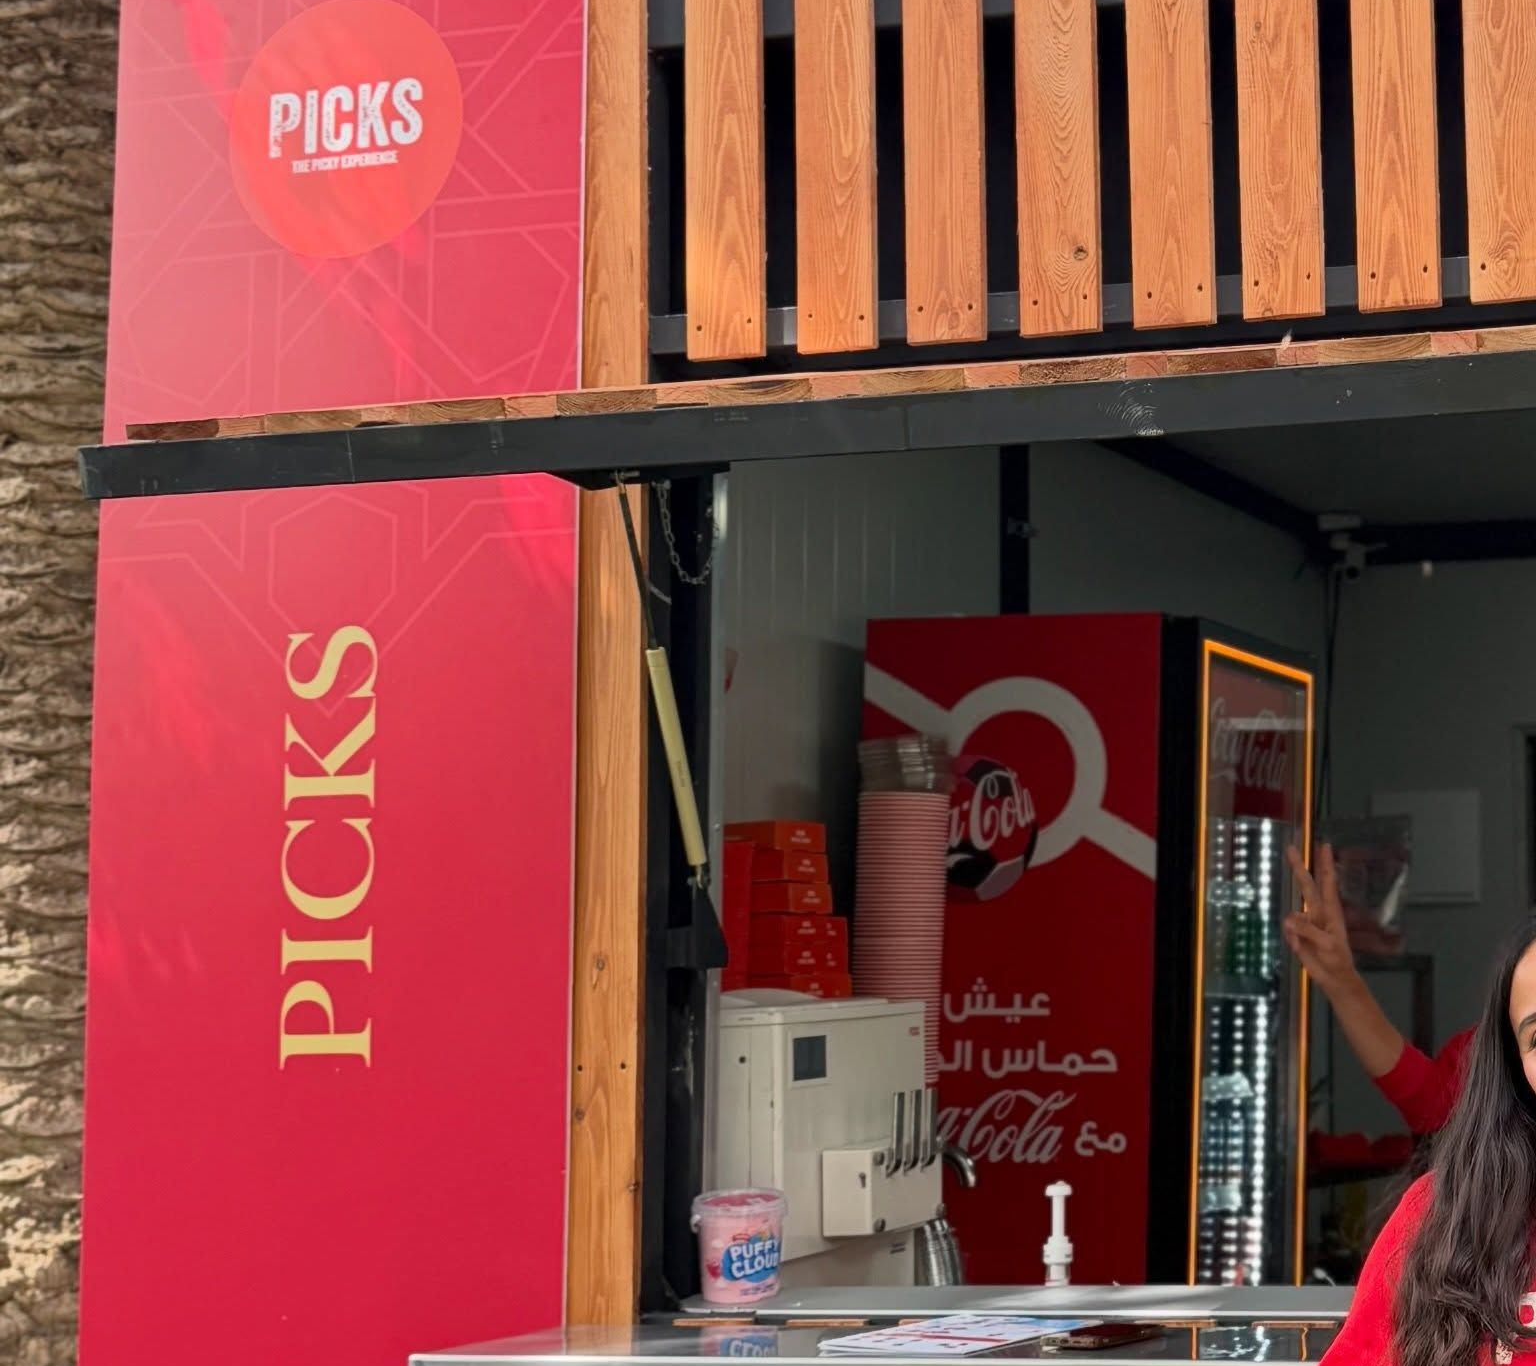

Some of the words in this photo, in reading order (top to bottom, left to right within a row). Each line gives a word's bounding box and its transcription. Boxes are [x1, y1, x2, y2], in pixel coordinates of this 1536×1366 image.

[268, 77, 424, 159] PICKS
[278, 625, 378, 1071] PICKS
[943, 976, 1051, 1024] عيش
[982, 1040, 1118, 1079] حماس
[936, 1088, 1078, 1164] a-Cola
[1074, 1120, 1127, 1156] مع
[730, 1239, 779, 1261] PUFFY
